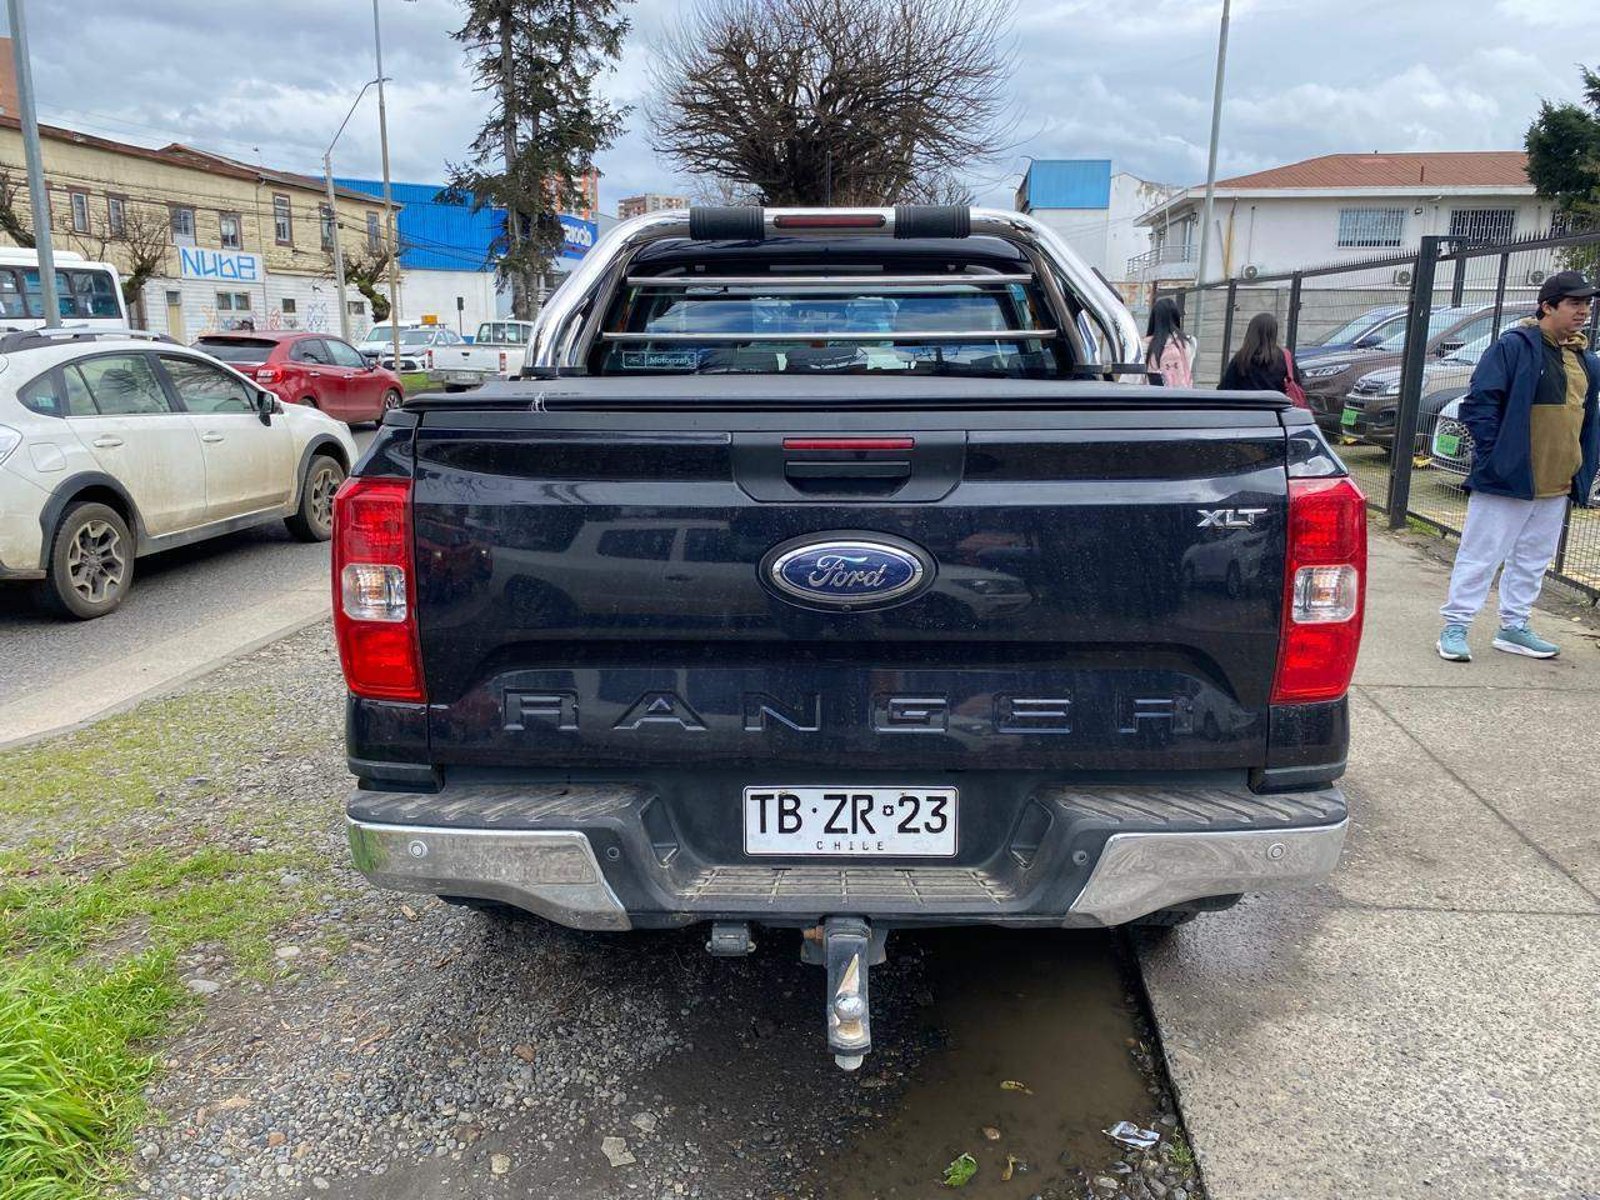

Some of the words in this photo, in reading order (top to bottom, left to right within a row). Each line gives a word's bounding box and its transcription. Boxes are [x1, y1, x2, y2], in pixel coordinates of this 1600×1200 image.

[1196, 507, 1269, 529] XLT
[808, 554, 888, 588] Ford
[502, 689, 1195, 734] RANGER
[815, 840, 885, 851] CHILE
